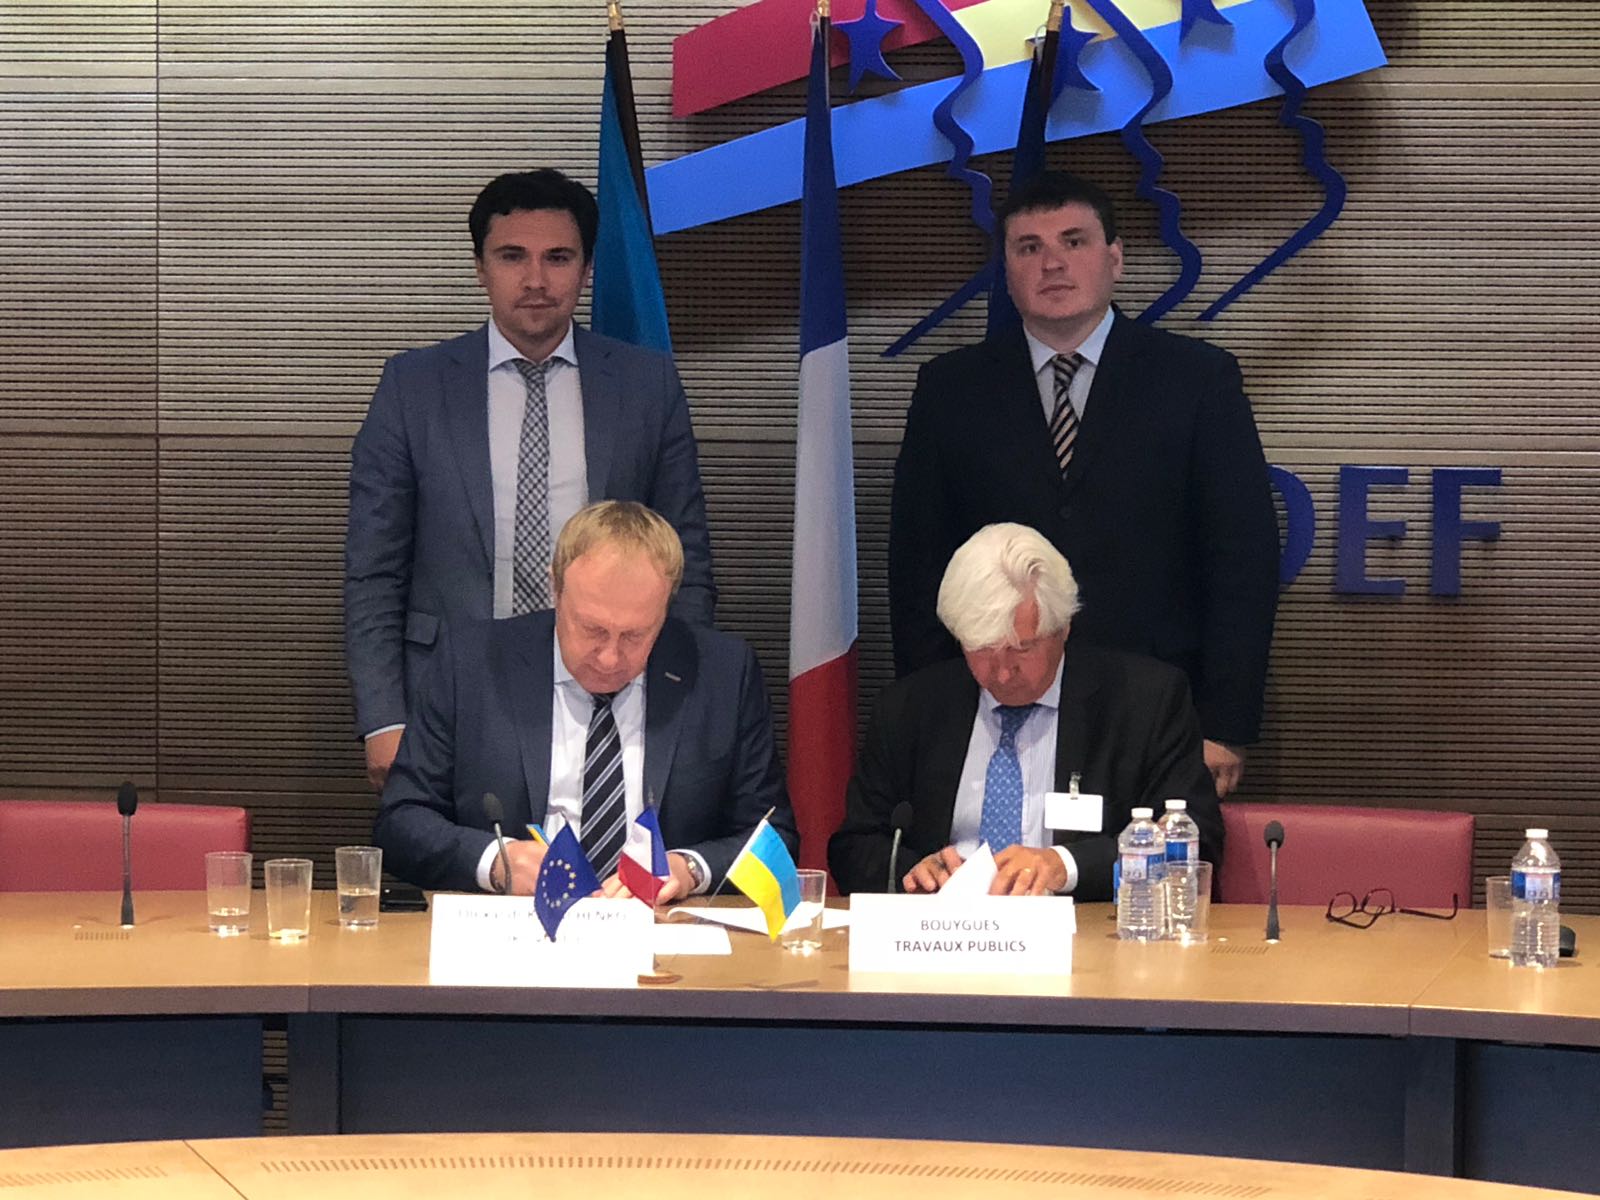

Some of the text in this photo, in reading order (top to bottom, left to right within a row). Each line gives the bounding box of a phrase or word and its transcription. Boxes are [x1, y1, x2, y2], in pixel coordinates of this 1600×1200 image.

[920, 919, 1000, 931] BOUYGUES
[895, 940, 1026, 953] TRAVAUX PUBLICS
